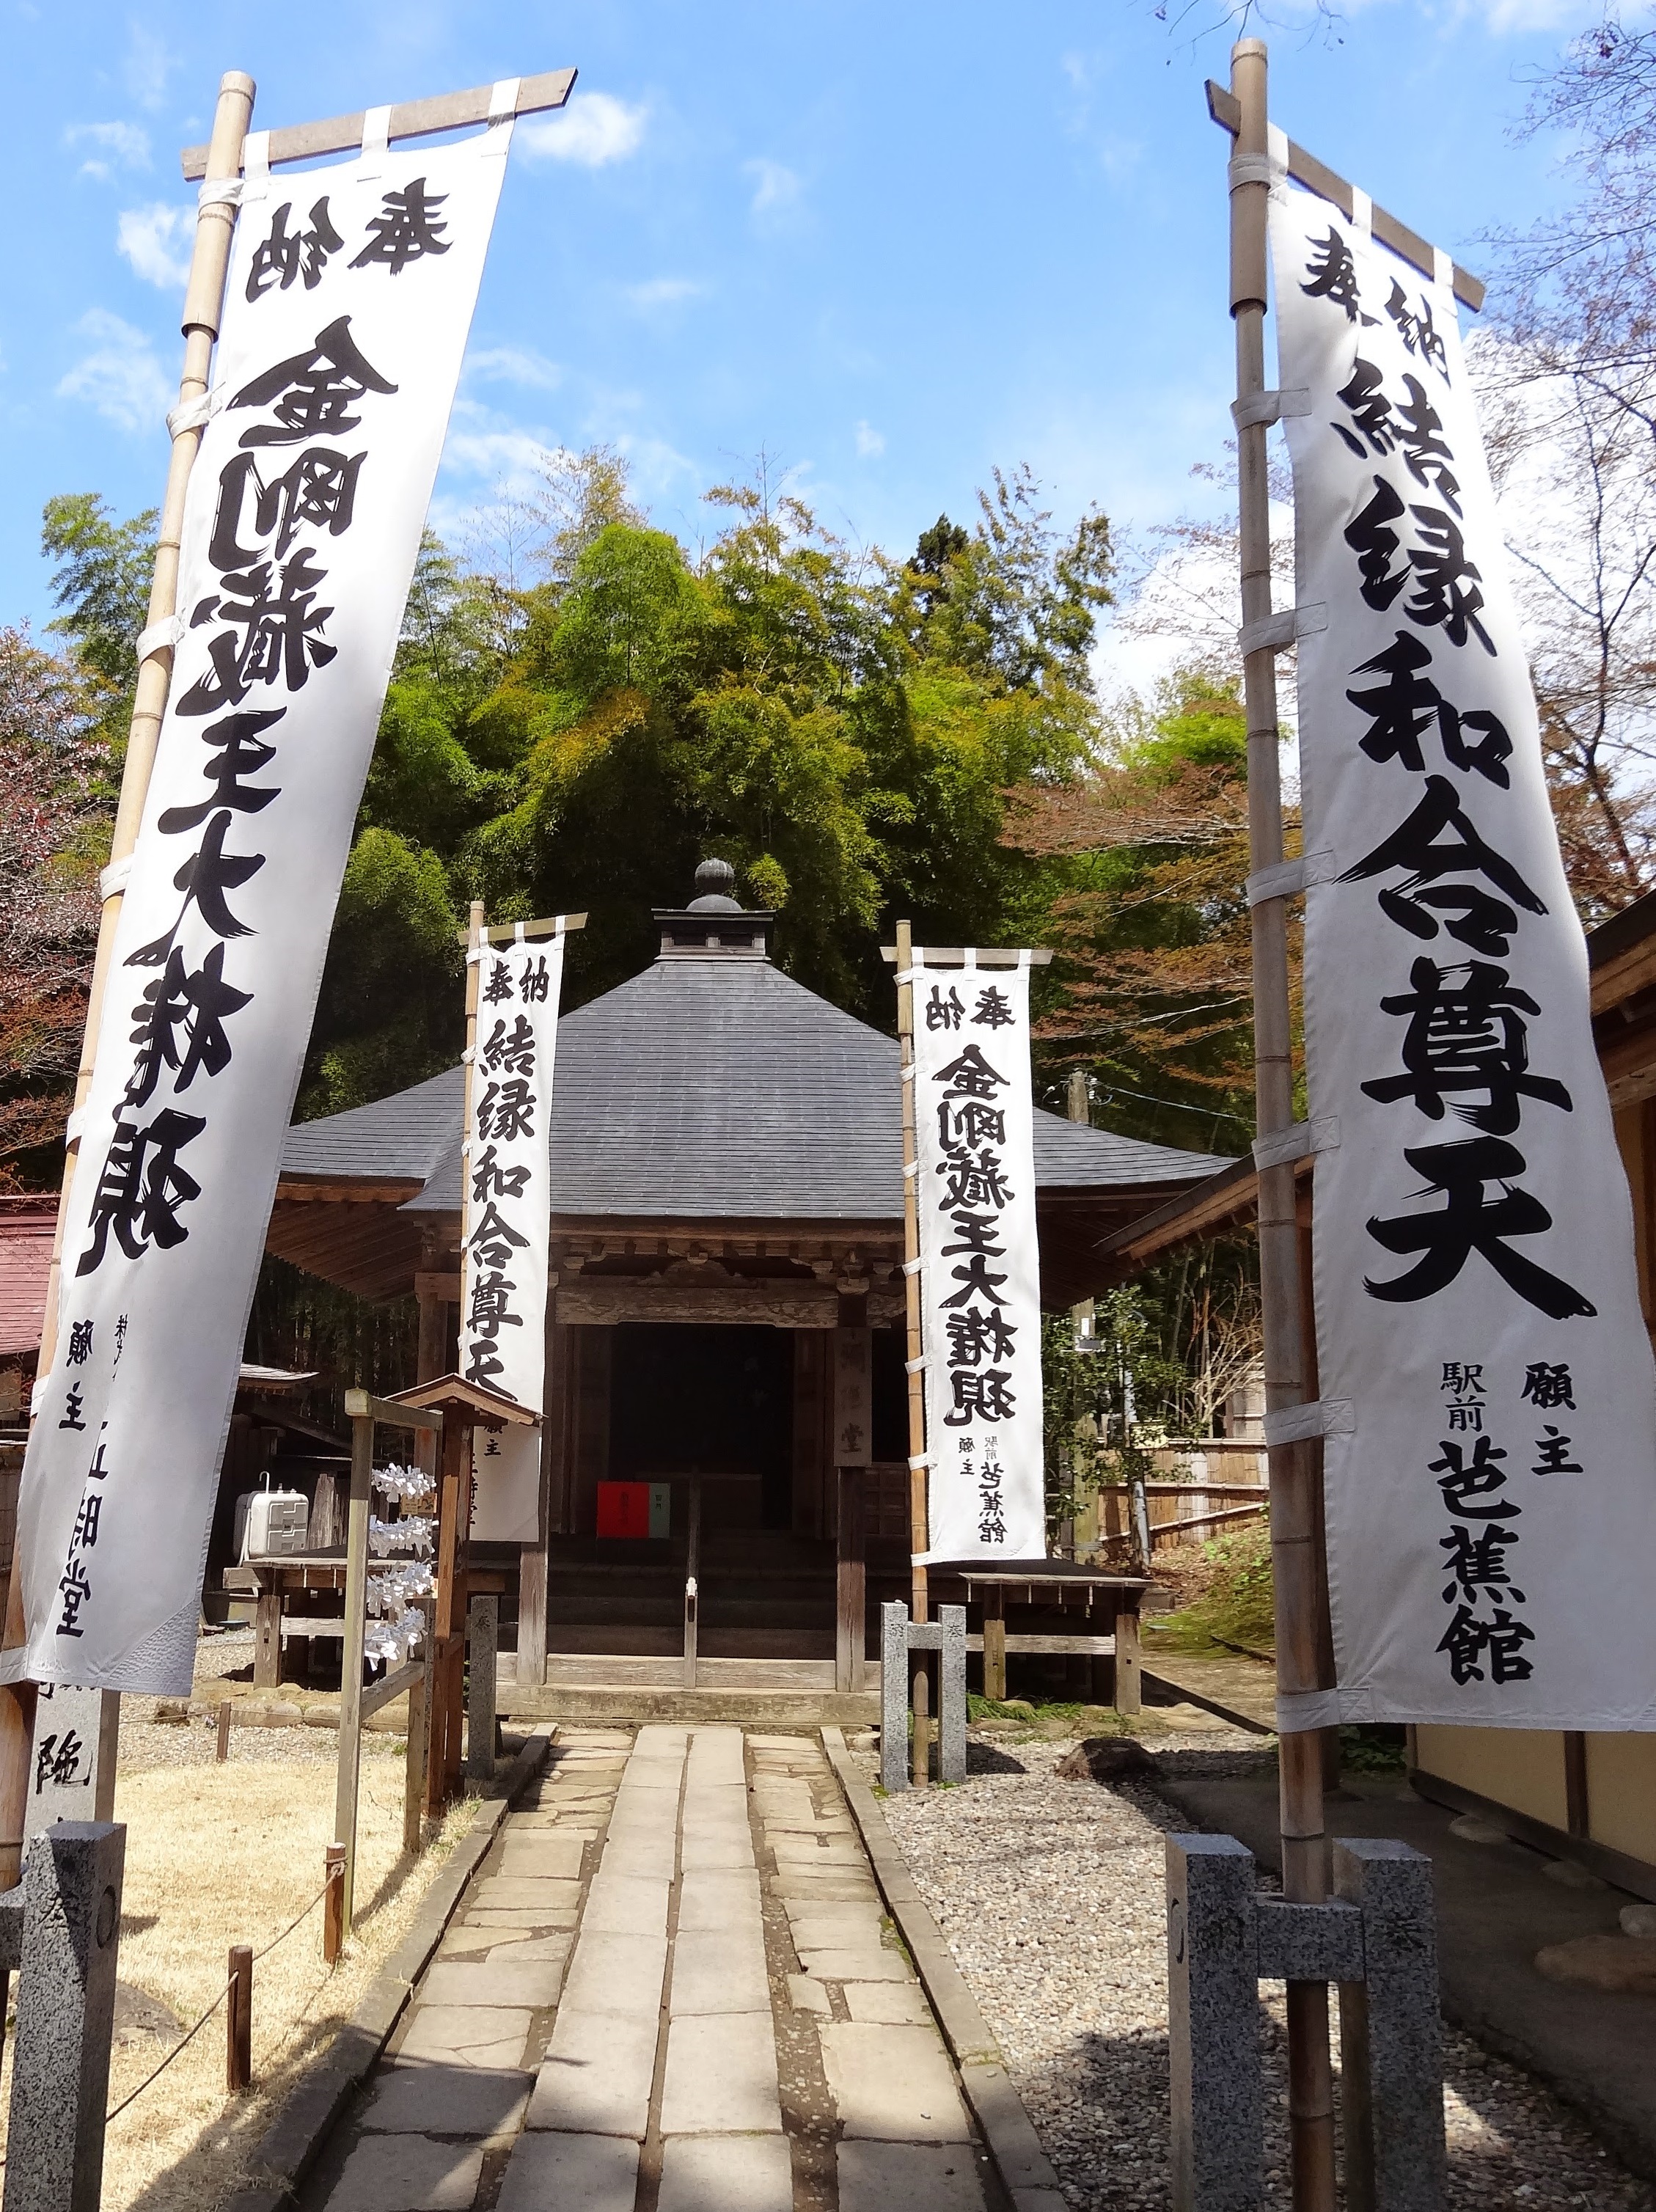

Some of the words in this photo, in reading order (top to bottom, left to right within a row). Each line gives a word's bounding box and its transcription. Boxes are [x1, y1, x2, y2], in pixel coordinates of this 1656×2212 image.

[1300, 224, 1451, 388] 奉納
[483, 956, 549, 1006] 奉納
[1520, 1362, 1583, 1476] 願主
